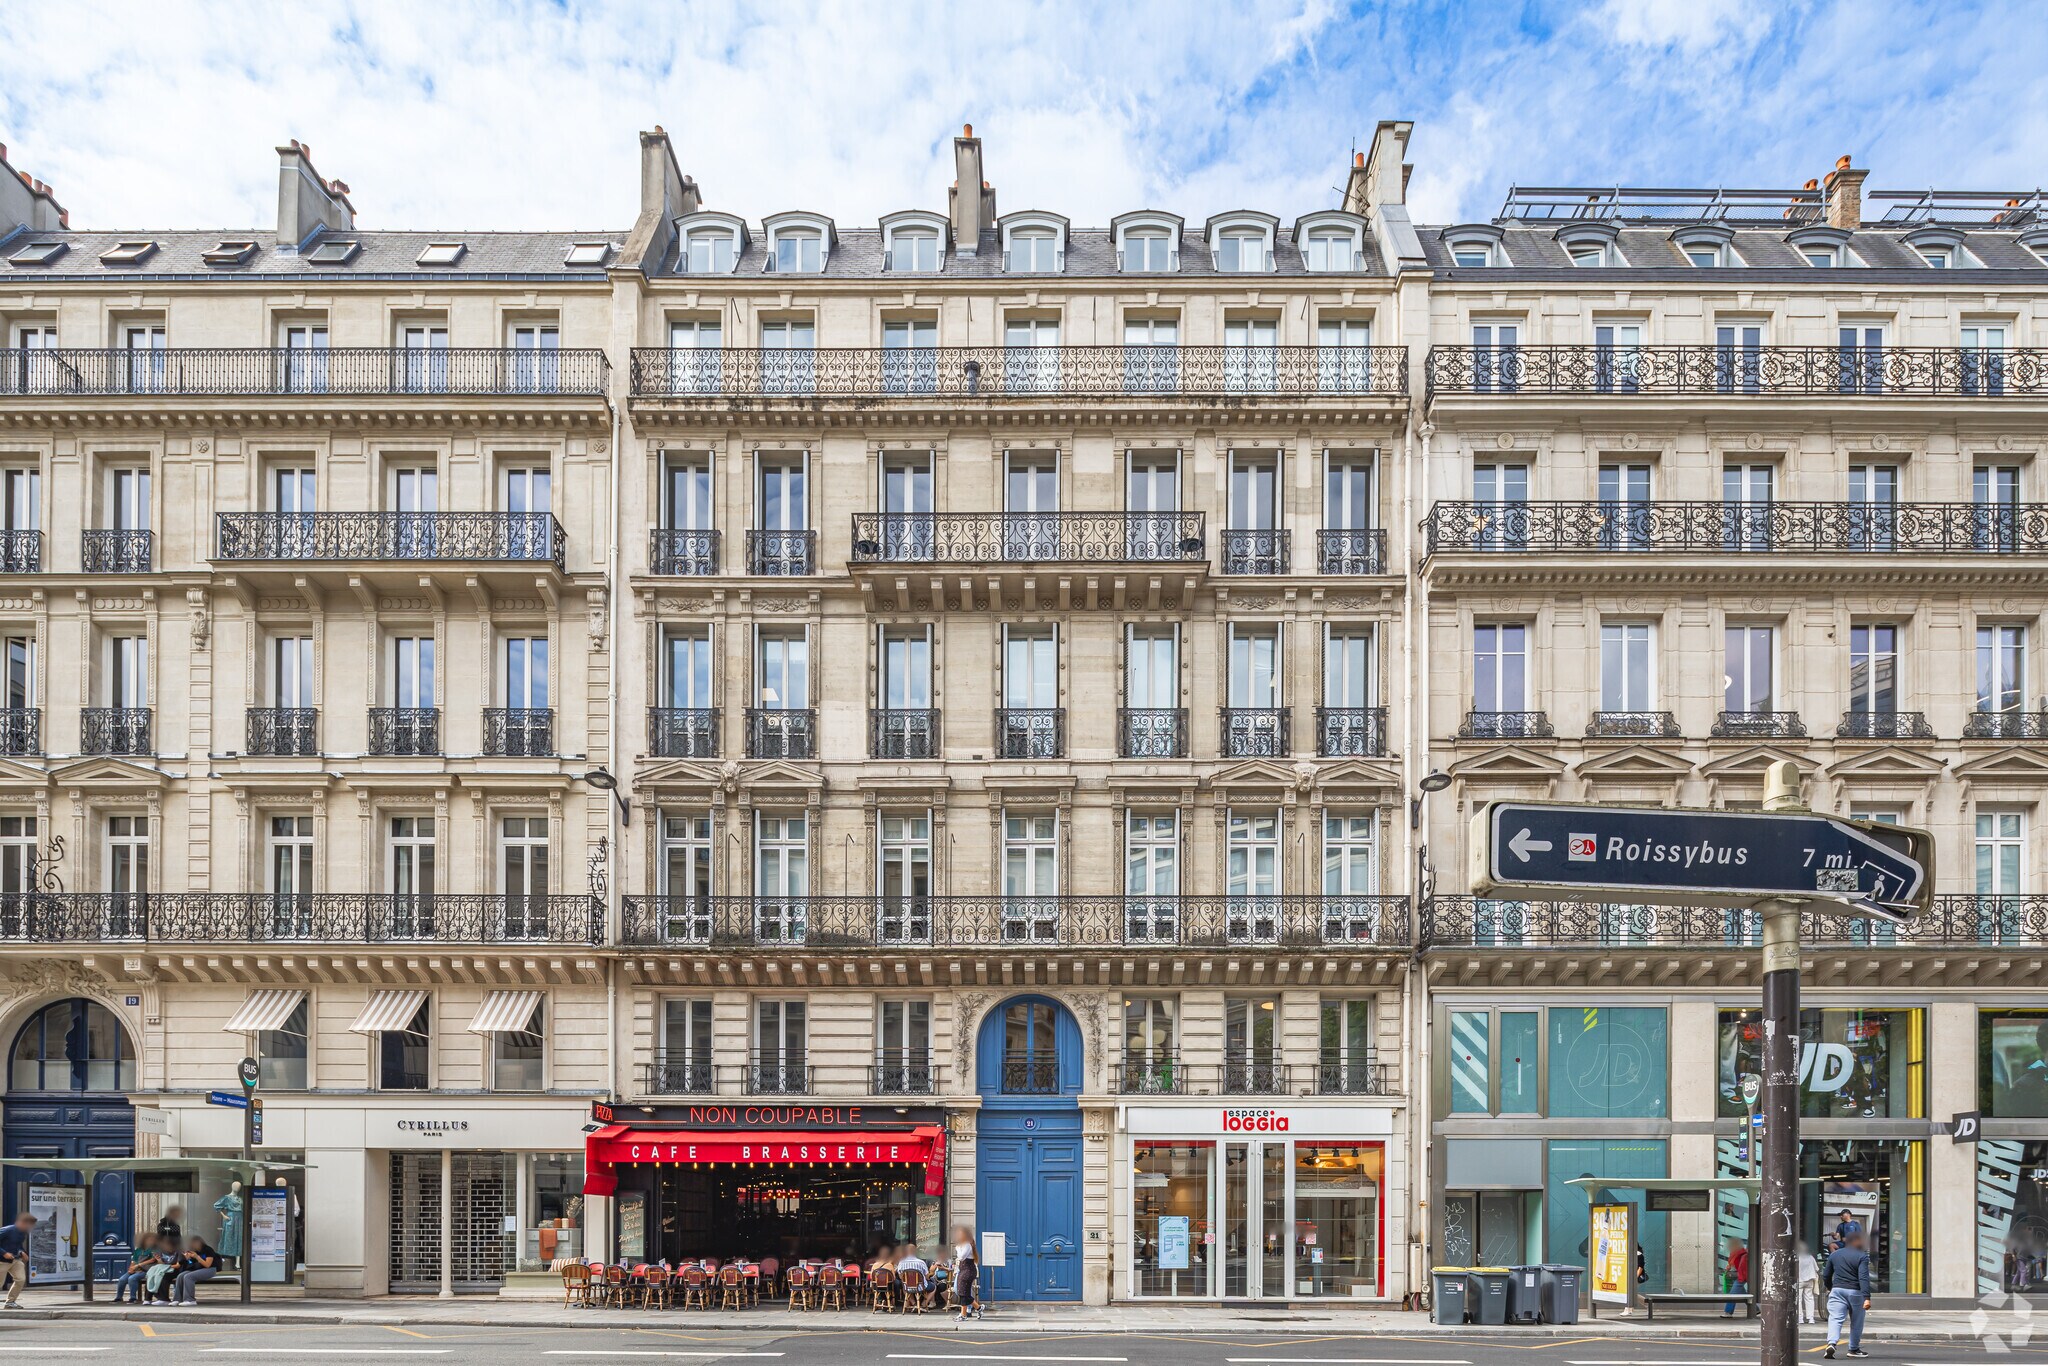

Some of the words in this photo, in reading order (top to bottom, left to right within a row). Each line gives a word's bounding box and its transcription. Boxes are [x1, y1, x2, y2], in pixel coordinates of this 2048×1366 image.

[1605, 837, 1748, 868] Roissybus
[1803, 849, 1815, 867] 7
[128, 996, 137, 1005] 19
[244, 1064, 257, 1075] BUS
[1744, 1082, 1757, 1092] BUS
[596, 1105, 613, 1121] PIZZA
[690, 1107, 736, 1123] NON
[745, 1107, 862, 1124] COUPABLE
[1228, 1110, 1269, 1119] espace
[397, 1120, 468, 1130] CYRILLUS
[1954, 1118, 1976, 1138] JD
[632, 1146, 697, 1159] CAFE
[743, 1146, 898, 1159] BRASSERIE
[57, 1195, 83, 1203] terrasse
[1593, 1212, 1607, 1230] 30
[1608, 1240, 1627, 1254] PRIX
